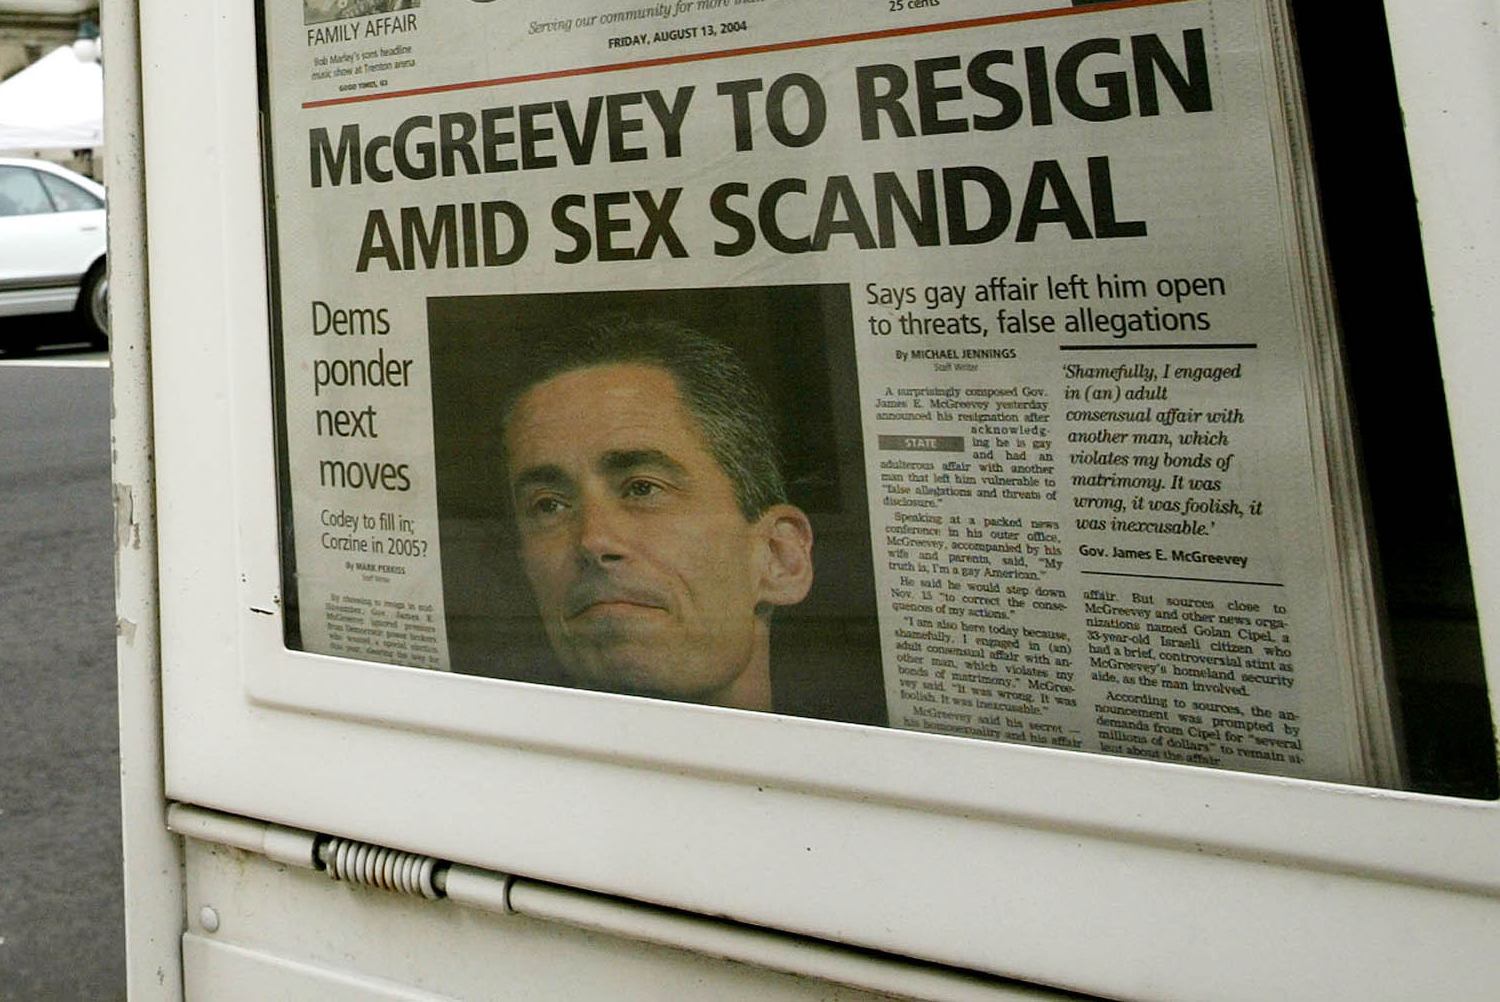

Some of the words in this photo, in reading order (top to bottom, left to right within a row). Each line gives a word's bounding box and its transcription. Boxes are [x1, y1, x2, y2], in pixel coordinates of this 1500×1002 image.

[528, 17, 573, 35] Serving
[575, 15, 596, 27] our
[600, 2, 672, 25] community
[673, 0, 693, 17] for
[889, 0, 903, 12] 25
[307, 22, 360, 46] FAMILY
[365, 13, 417, 37] AFFAIR
[608, 33, 650, 49] FRIDAY,
[653, 27, 698, 43] AUGUST
[701, 25, 717, 37] 13,
[721, 21, 747, 34] 2004
[380, 44, 412, 57] headline
[364, 61, 392, 73] Trenton
[309, 84, 696, 188] McGREEVEY
[716, 73, 828, 151] TO
[858, 27, 1216, 142] RESIGN
[355, 199, 530, 274] AMID
[553, 186, 690, 263] SEX
[712, 155, 1149, 259] SCANDAL
[866, 282, 916, 310] Says
[924, 284, 966, 309] gay
[975, 276, 1039, 302] affair
[1048, 274, 1088, 300] left
[1096, 274, 1147, 299] him
[1156, 276, 1226, 303] open
[311, 300, 390, 337] Dems
[868, 315, 892, 336] to
[900, 311, 988, 338] threats,
[997, 309, 1055, 334] false
[1065, 306, 1212, 339] allegations
[896, 350, 908, 361] By
[911, 349, 959, 360] MICHAEL
[962, 348, 1016, 359] JENNINGS
[313, 348, 414, 396] ponder
[1162, 363, 1170, 379] I
[1174, 363, 1242, 382] engaged
[1065, 387, 1080, 399] in
[1085, 385, 1121, 403] (an)
[1125, 386, 1168, 400] adult
[316, 405, 378, 439] next
[1066, 408, 1151, 422] consensual
[1156, 408, 1203, 425] affair
[1206, 408, 1244, 423] with
[1068, 429, 1129, 444] another
[1132, 432, 1173, 447] man,
[1179, 430, 1229, 446] which
[1070, 451, 1129, 466] violates
[1133, 456, 1159, 470] my
[1164, 453, 1212, 469] bonds
[1216, 454, 1234, 472] of
[320, 458, 412, 492] moves
[1071, 473, 1165, 492] matrimony.
[1170, 475, 1184, 490] It
[1189, 479, 1222, 491] was
[1073, 496, 1126, 512] wrong,
[1132, 496, 1144, 510] it
[1149, 500, 1180, 512] was
[1181, 499, 1244, 518] foolish,
[1249, 500, 1263, 516] it
[321, 509, 359, 533] Codey
[363, 514, 375, 530] to
[379, 512, 395, 531] fill
[399, 514, 415, 535] in;
[1076, 518, 1107, 530] was
[322, 532, 368, 552] Corzine
[372, 536, 383, 553] in
[388, 537, 428, 557] 2005?
[1079, 544, 1109, 558] Gov.
[1112, 547, 1152, 560] James
[1156, 550, 1168, 561] E.
[1172, 551, 1248, 568] McGreevey
[1132, 592, 1154, 605] But
[1166, 597, 1214, 610] sources
[1227, 599, 1260, 613] close
[1273, 603, 1286, 615] to
[1085, 603, 1151, 619] McGreevey
[1155, 609, 1178, 620] and
[1182, 611, 1215, 623] other
[1219, 614, 1251, 626] news
[1255, 618, 1288, 630] orga-
[1086, 617, 1140, 631] nizations
[1147, 623, 1187, 635] named
[1194, 625, 1231, 639] Golan
[1282, 635, 1289, 644] a
[1087, 630, 1150, 645] 33-year-old
[1161, 636, 1200, 650] Israeli
[1210, 640, 1253, 655] citizen
[1264, 646, 1292, 657] who
[1089, 644, 1111, 656] had
[1114, 648, 1121, 656] a
[1159, 652, 1242, 668] controversial
[1245, 658, 1276, 671] stint
[1279, 662, 1293, 672] as
[1123, 675, 1136, 685] as
[1139, 675, 1158, 687] the
[1161, 679, 1189, 691] man
[1192, 682, 1250, 697] involved.
[1173, 665, 1234, 681] homeland
[1241, 673, 1294, 688] security
